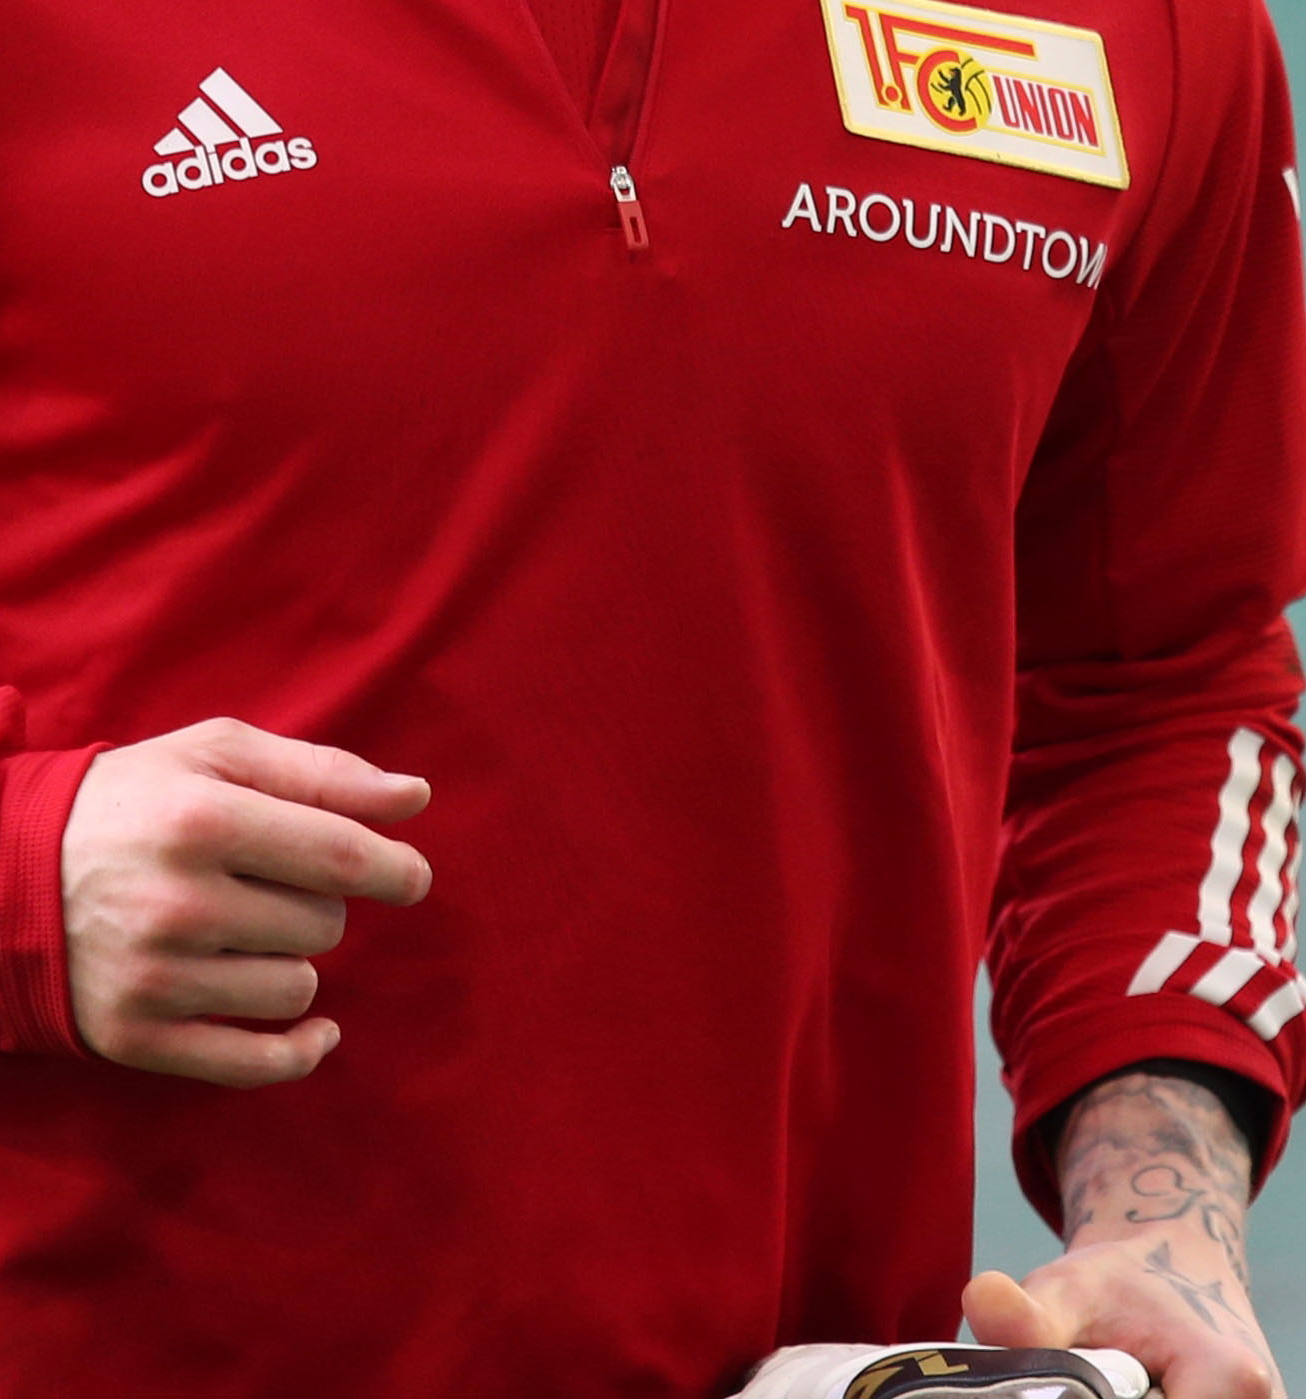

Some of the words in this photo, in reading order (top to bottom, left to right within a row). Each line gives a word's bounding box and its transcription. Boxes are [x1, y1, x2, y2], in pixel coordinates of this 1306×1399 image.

[992, 74, 1099, 148] UNION
[142, 136, 318, 198] adidas
[781, 182, 1108, 291] AROUNDTOW
